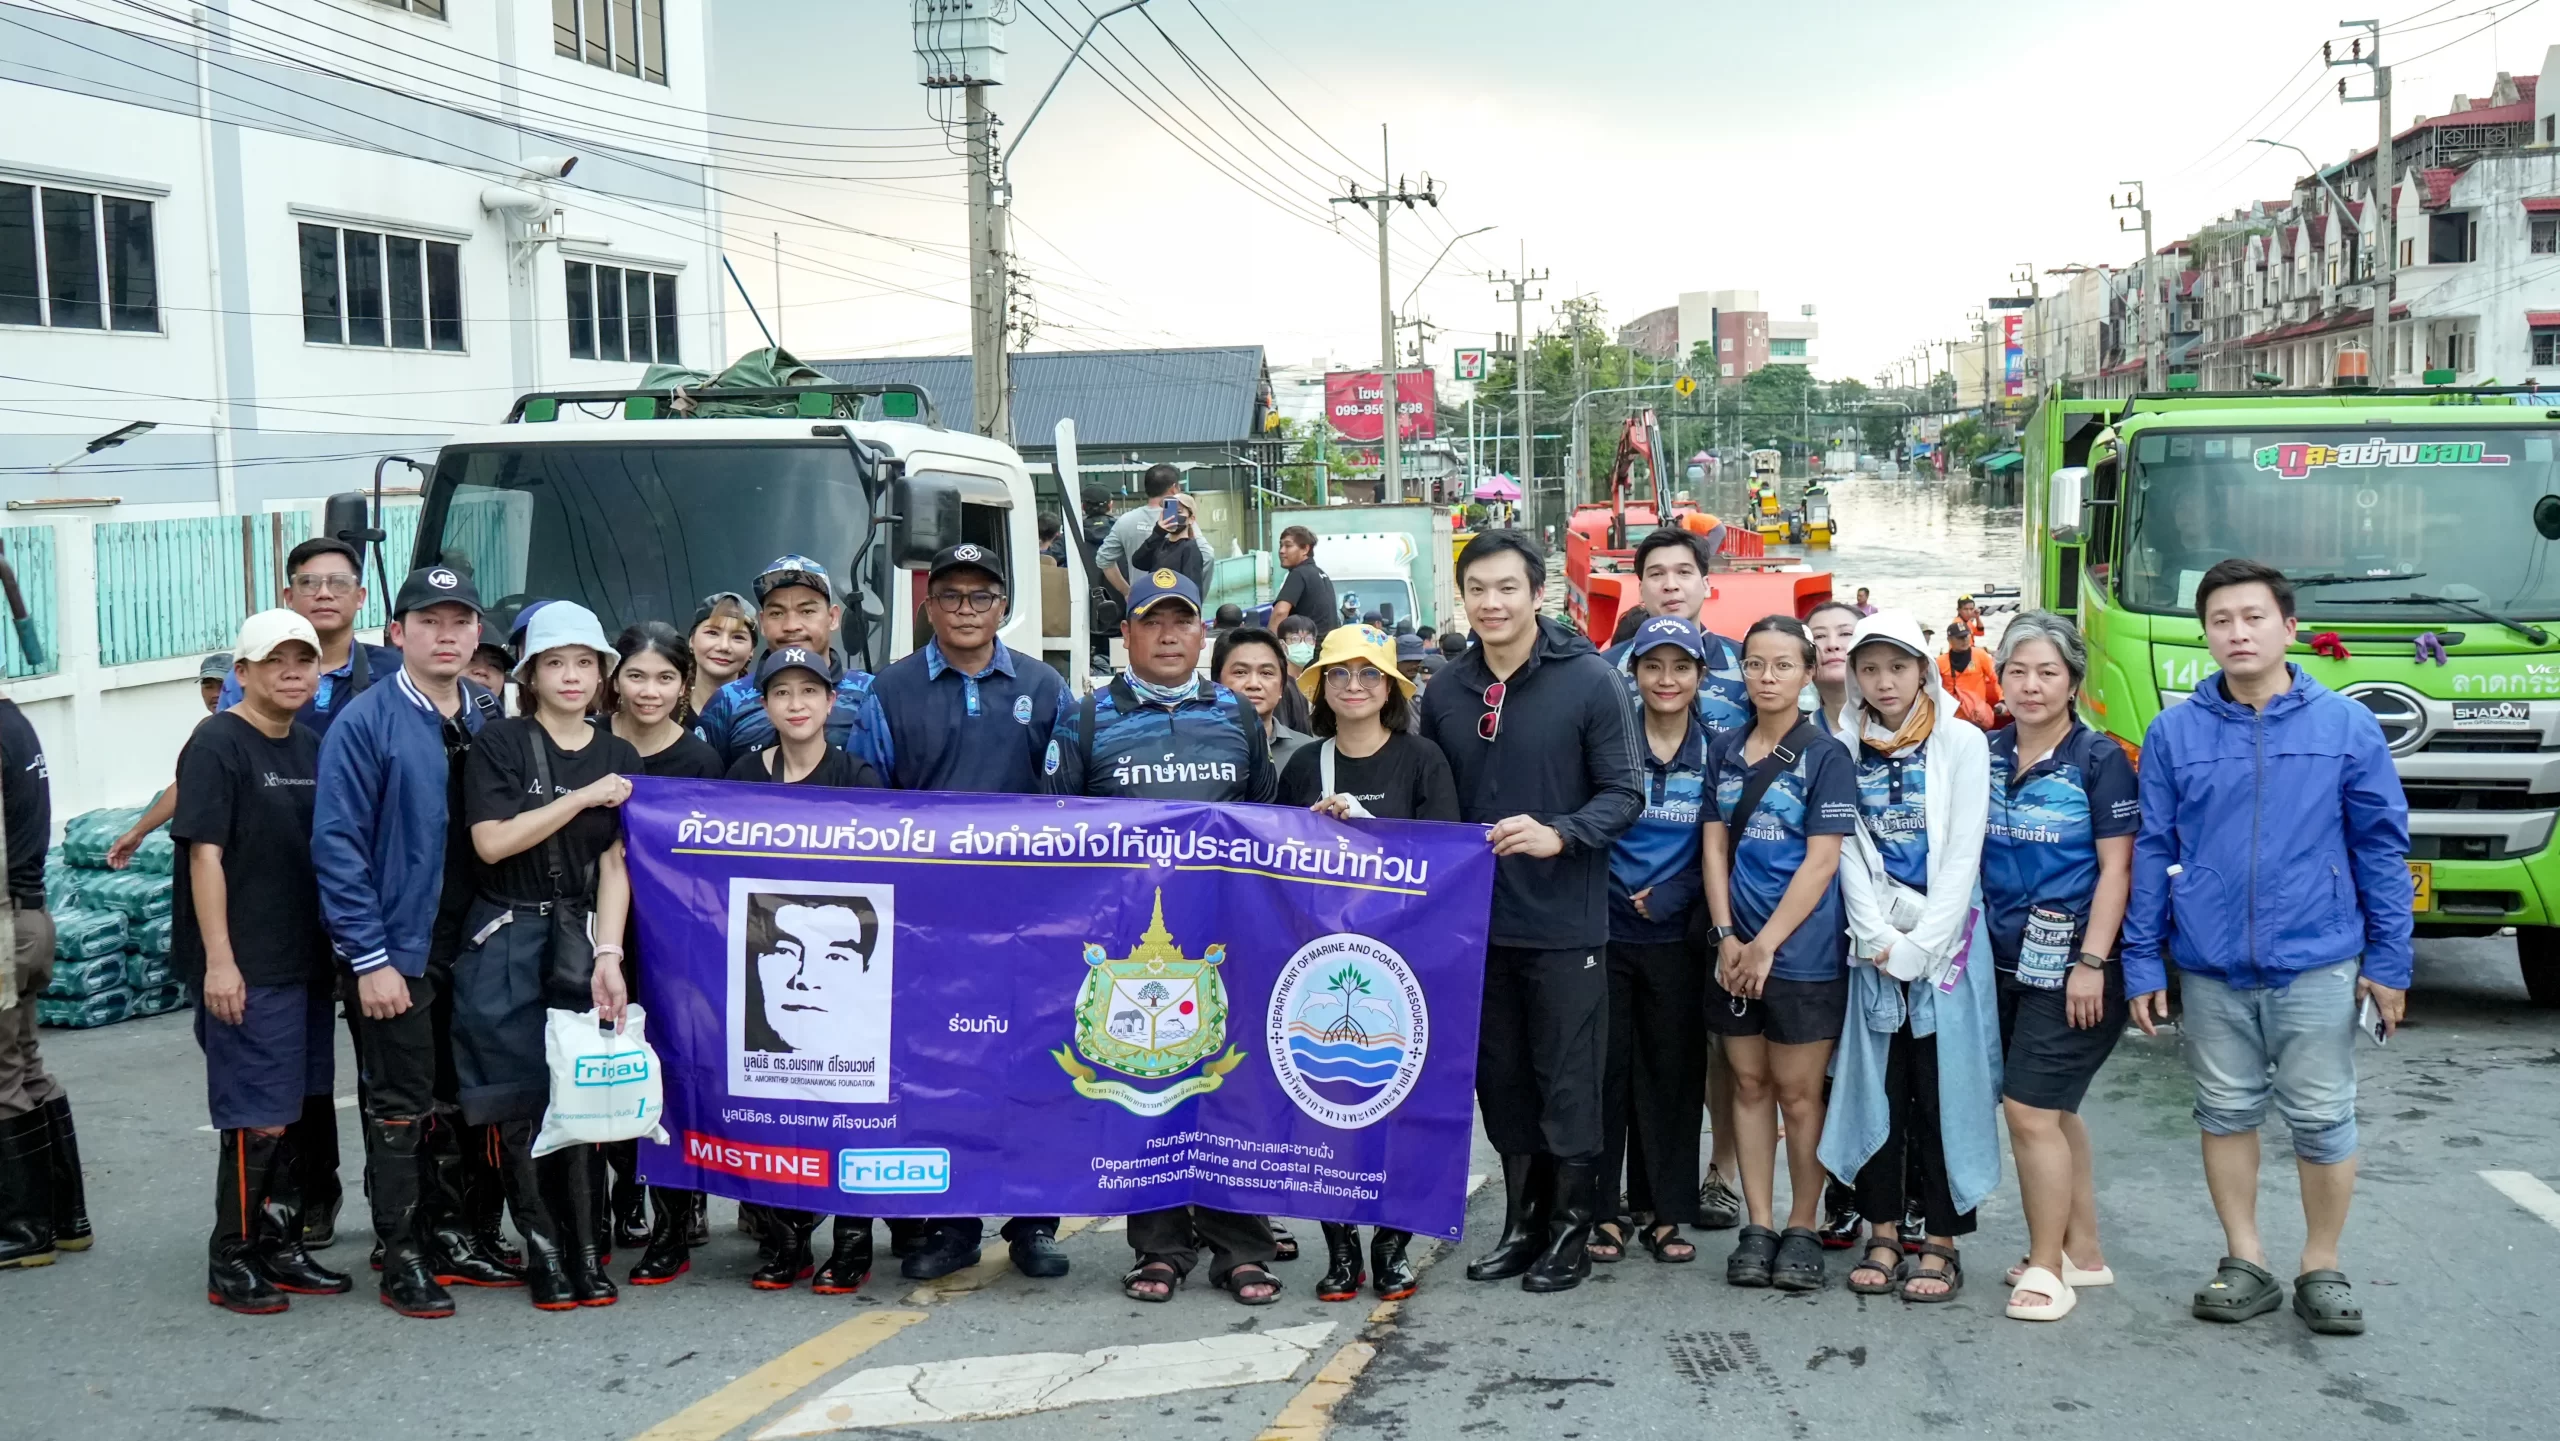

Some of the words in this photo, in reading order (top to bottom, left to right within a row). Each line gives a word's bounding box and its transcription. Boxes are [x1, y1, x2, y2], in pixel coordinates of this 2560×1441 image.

[1358, 386, 1398, 400] โฆษ
[1648, 619, 1690, 634] Callaway
[785, 649, 806, 662] NY
[2526, 664, 2560, 675] VIC
[2455, 702, 2527, 719] SHADOW
[1113, 753, 1237, 786] รักษ์ทะเล
[678, 811, 936, 853] ด้วยความห่วงใย
[950, 822, 1428, 885] ส่งกำลังใจให้ผู้ประสบภัยน้ำท่วม
[1272, 967, 1303, 1029] DEPARTMENT
[1298, 957, 1310, 969] OF
[1309, 942, 1346, 961] MARINE
[1348, 942, 1371, 955] AND
[1372, 949, 1406, 986] COASTAL
[1403, 985, 1424, 1045] RESOURCES
[948, 1012, 1009, 1033] ร่วมกับ
[575, 1057, 648, 1081] Friday
[744, 1054, 769, 1072] มูลนิธิ
[773, 1057, 824, 1072] ดร.อมรเทพ
[828, 1055, 875, 1073] ดีโรจนวงศ์
[744, 1074, 753, 1082] DR.
[755, 1075, 789, 1084] AMORNTHEP
[838, 1079, 875, 1088] FOUNDATION
[635, 1097, 646, 1118] 1
[722, 1108, 776, 1124] มูลนิธิดร.
[779, 1114, 829, 1128] อมรเทพ
[832, 1114, 897, 1130] ดีโรจนวงศ์
[1146, 1131, 1334, 1160] กรมทรัพยากรทางทะเลและชายฝั่ง
[690, 1138, 820, 1177] MISTINE
[1090, 1152, 1170, 1173] (Department
[1172, 1150, 1185, 1163] of
[1187, 1149, 1230, 1167] Marine
[1232, 1157, 1257, 1170] and
[1260, 1159, 1311, 1174] Coastal
[1313, 1164, 1388, 1184] Resources)
[840, 1154, 949, 1184] Friday
[1097, 1165, 1379, 1200] สังกัดกระทรวงทรัพยากรธรรมชาติและสิ่งแวดล้อม
